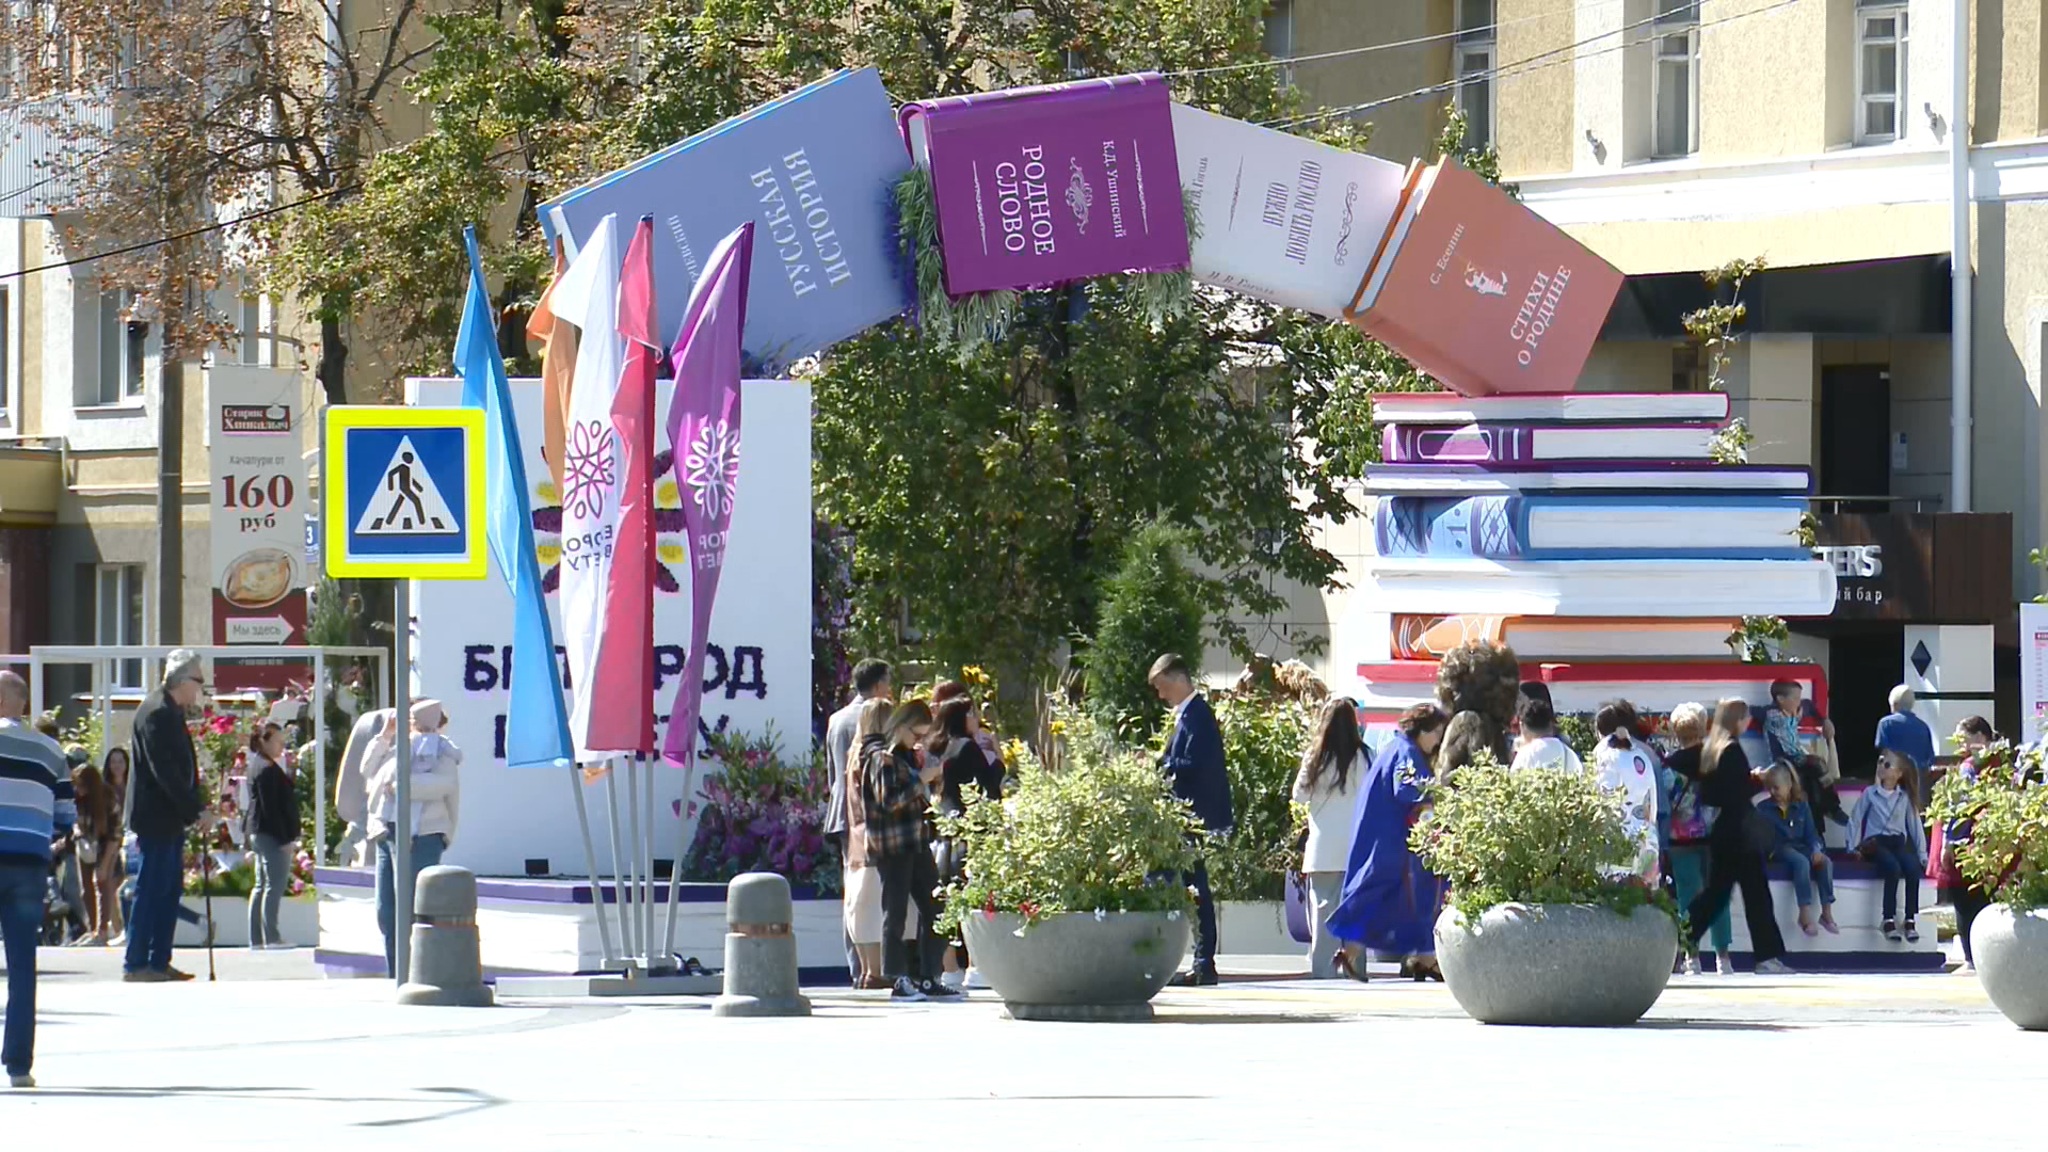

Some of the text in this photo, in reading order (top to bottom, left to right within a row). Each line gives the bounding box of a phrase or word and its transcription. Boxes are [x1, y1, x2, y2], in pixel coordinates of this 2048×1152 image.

[750, 166, 817, 299] РУССКАЯ
[783, 147, 851, 287] ИСТОРИЯ
[995, 162, 1026, 252] СЛОВО
[1022, 145, 1055, 255] РОДНОЕ
[1107, 169, 1126, 238] Ушинский
[1263, 182, 1289, 227] НУЖНО
[1285, 160, 1322, 265] ЛЮБИТЬ РОССИЮ
[1436, 223, 1465, 270] Есенин
[1510, 271, 1550, 340] СТИХИ
[1518, 265, 1571, 365] О РОДИНЕ
[222, 474, 294, 508] 160
[240, 512, 276, 532] руб
[1811, 545, 1883, 577] TERS
[1856, 586, 1883, 605] бар
[232, 624, 281, 636] Мы здесь
